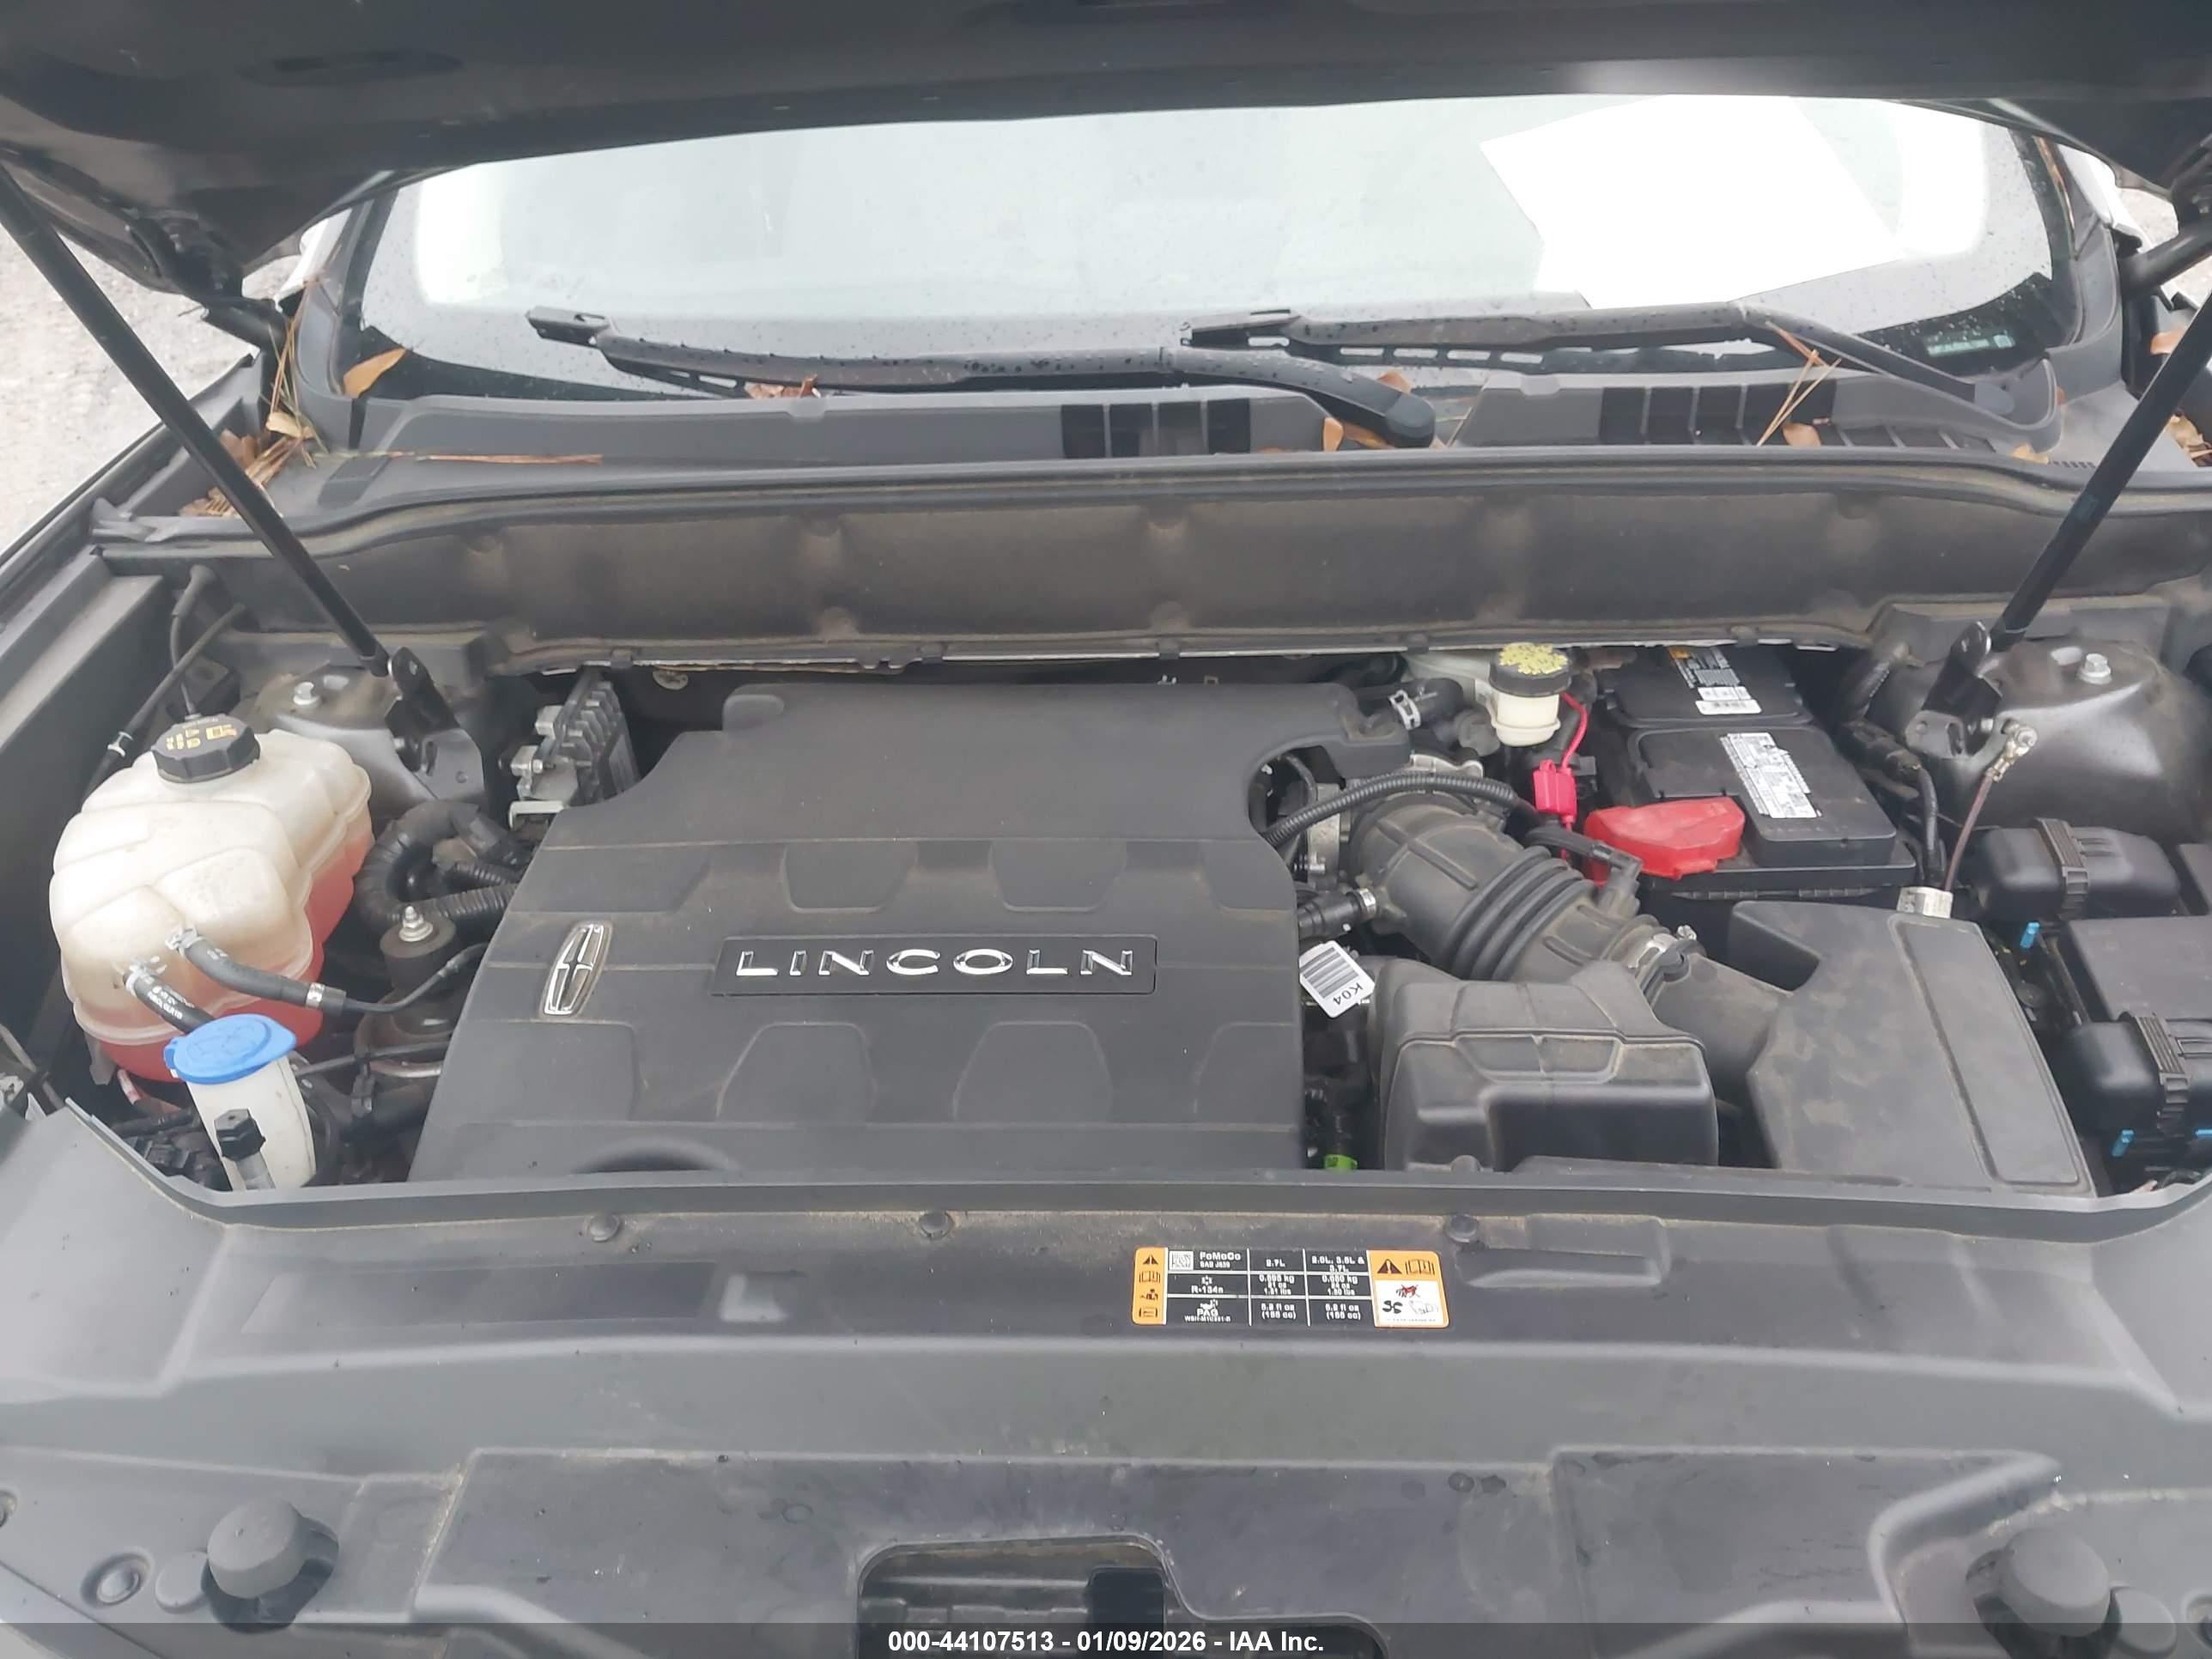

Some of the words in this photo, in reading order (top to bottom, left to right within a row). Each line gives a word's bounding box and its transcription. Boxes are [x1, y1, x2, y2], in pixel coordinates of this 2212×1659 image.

[736, 948, 1133, 976] LINCOLN
[1333, 982, 1364, 1005] K04
[1200, 1251, 1242, 1261] FoMoCo
[1266, 1259, 1285, 1267] 2.7L
[1284, 1273, 1295, 1284] kg
[1346, 1274, 1358, 1285] kg
[1191, 1285, 1224, 1294] R-134a
[1196, 1308, 1218, 1316] PAG
